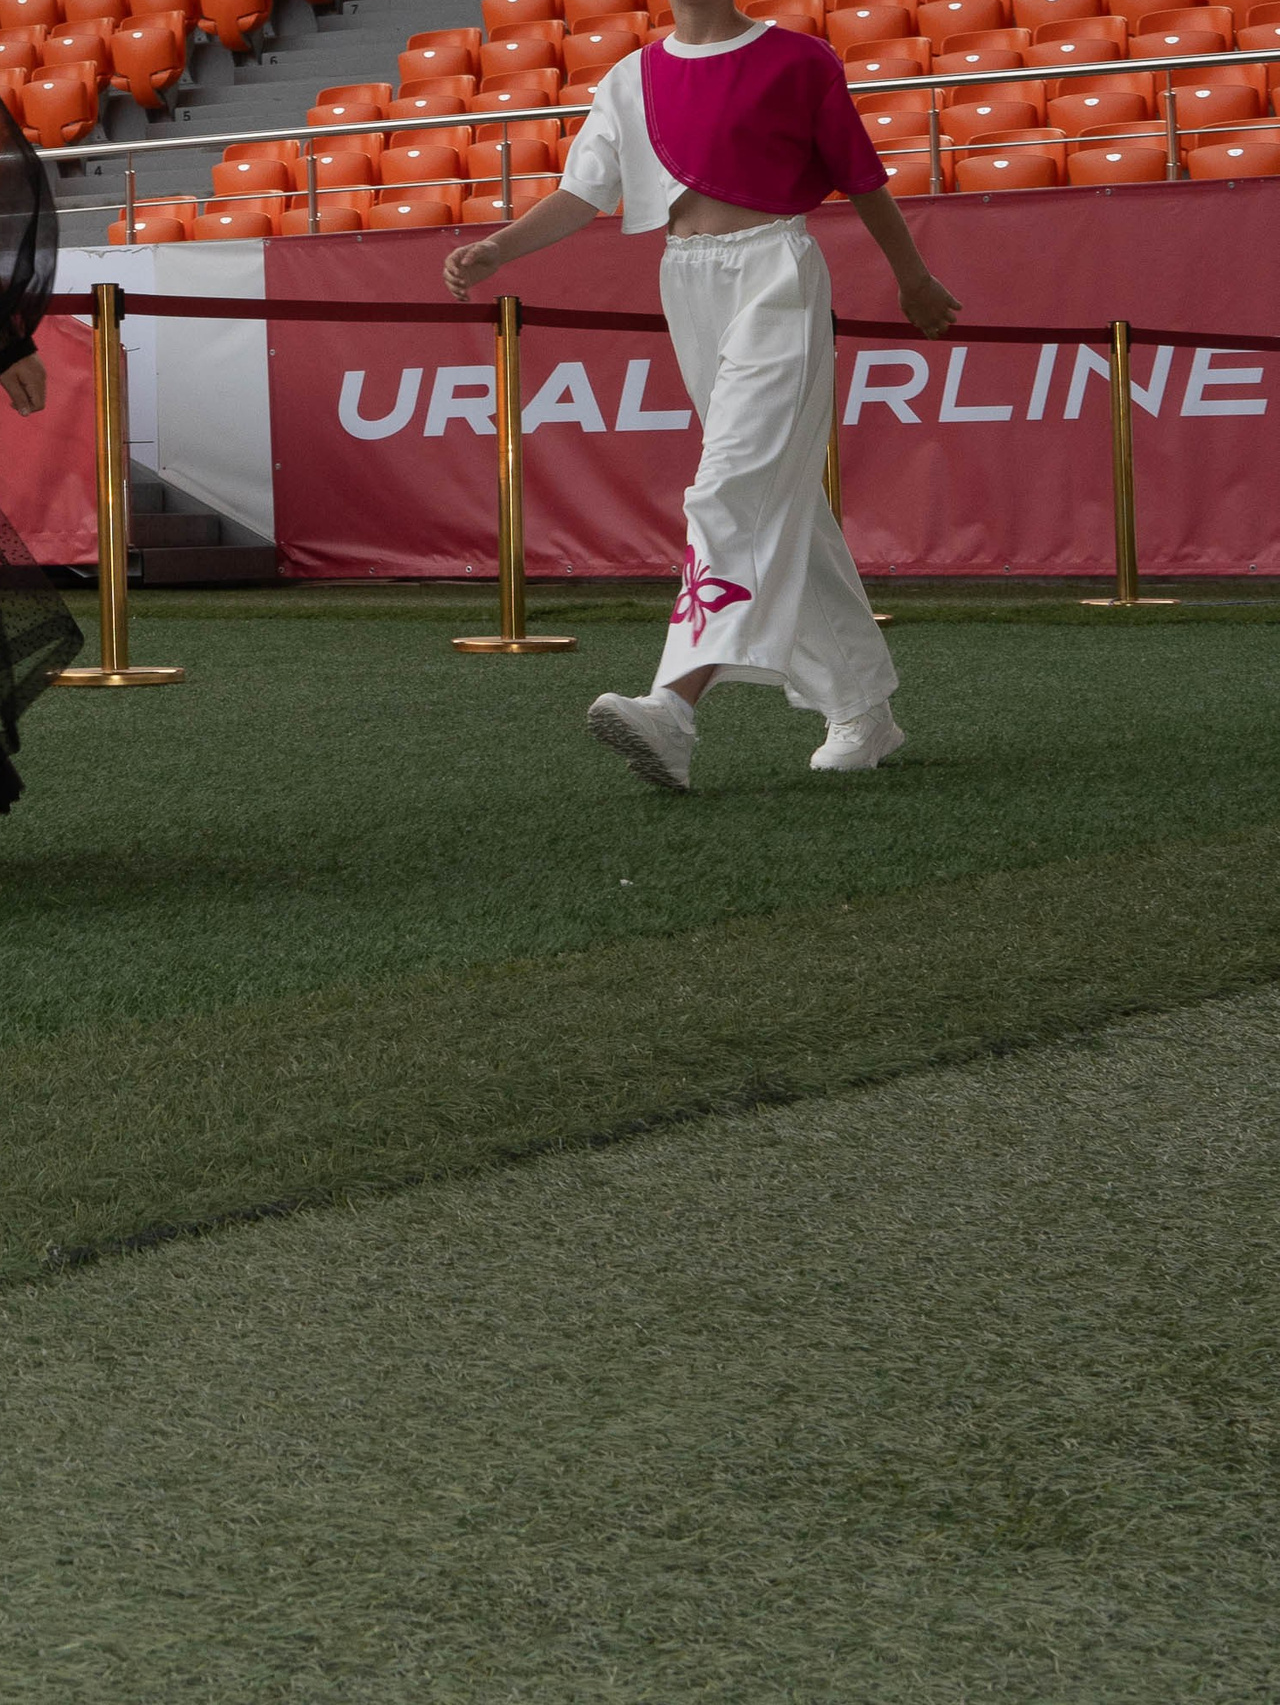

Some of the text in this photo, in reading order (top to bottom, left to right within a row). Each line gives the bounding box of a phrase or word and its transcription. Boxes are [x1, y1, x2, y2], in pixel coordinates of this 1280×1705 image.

[351, 4, 359, 15] 7
[183, 111, 191, 122] 5
[94, 166, 102, 175] 4
[338, 343, 1268, 440] URAL RLINE
